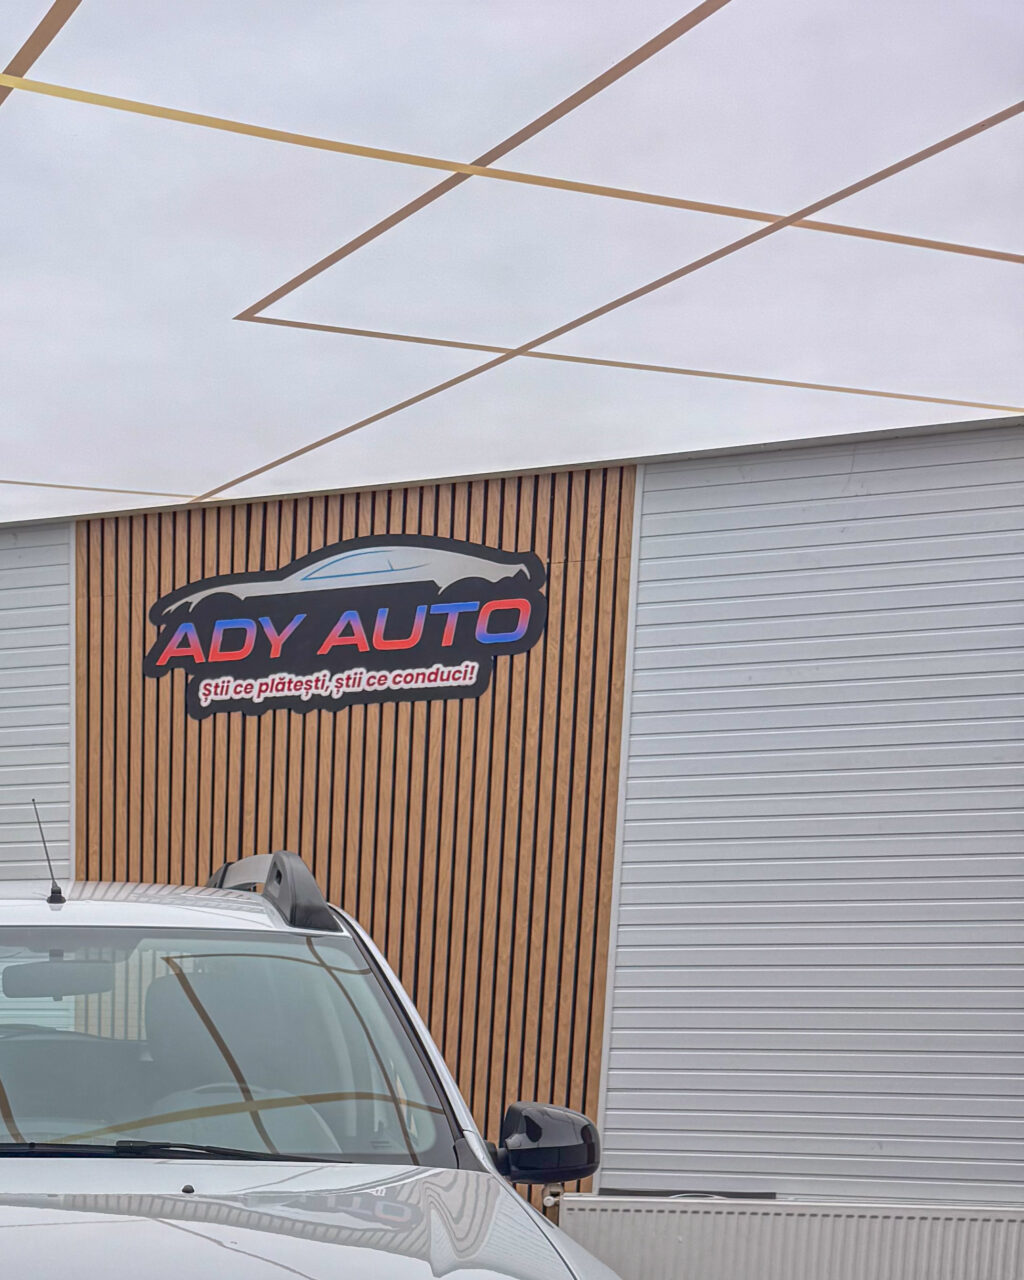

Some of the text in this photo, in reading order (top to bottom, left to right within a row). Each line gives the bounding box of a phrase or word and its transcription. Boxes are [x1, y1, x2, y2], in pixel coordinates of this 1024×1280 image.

[156, 598, 532, 665] ADY AUTO
[233, 683, 254, 696] ce
[366, 673, 388, 688] ce
[391, 664, 477, 686] conduci!
